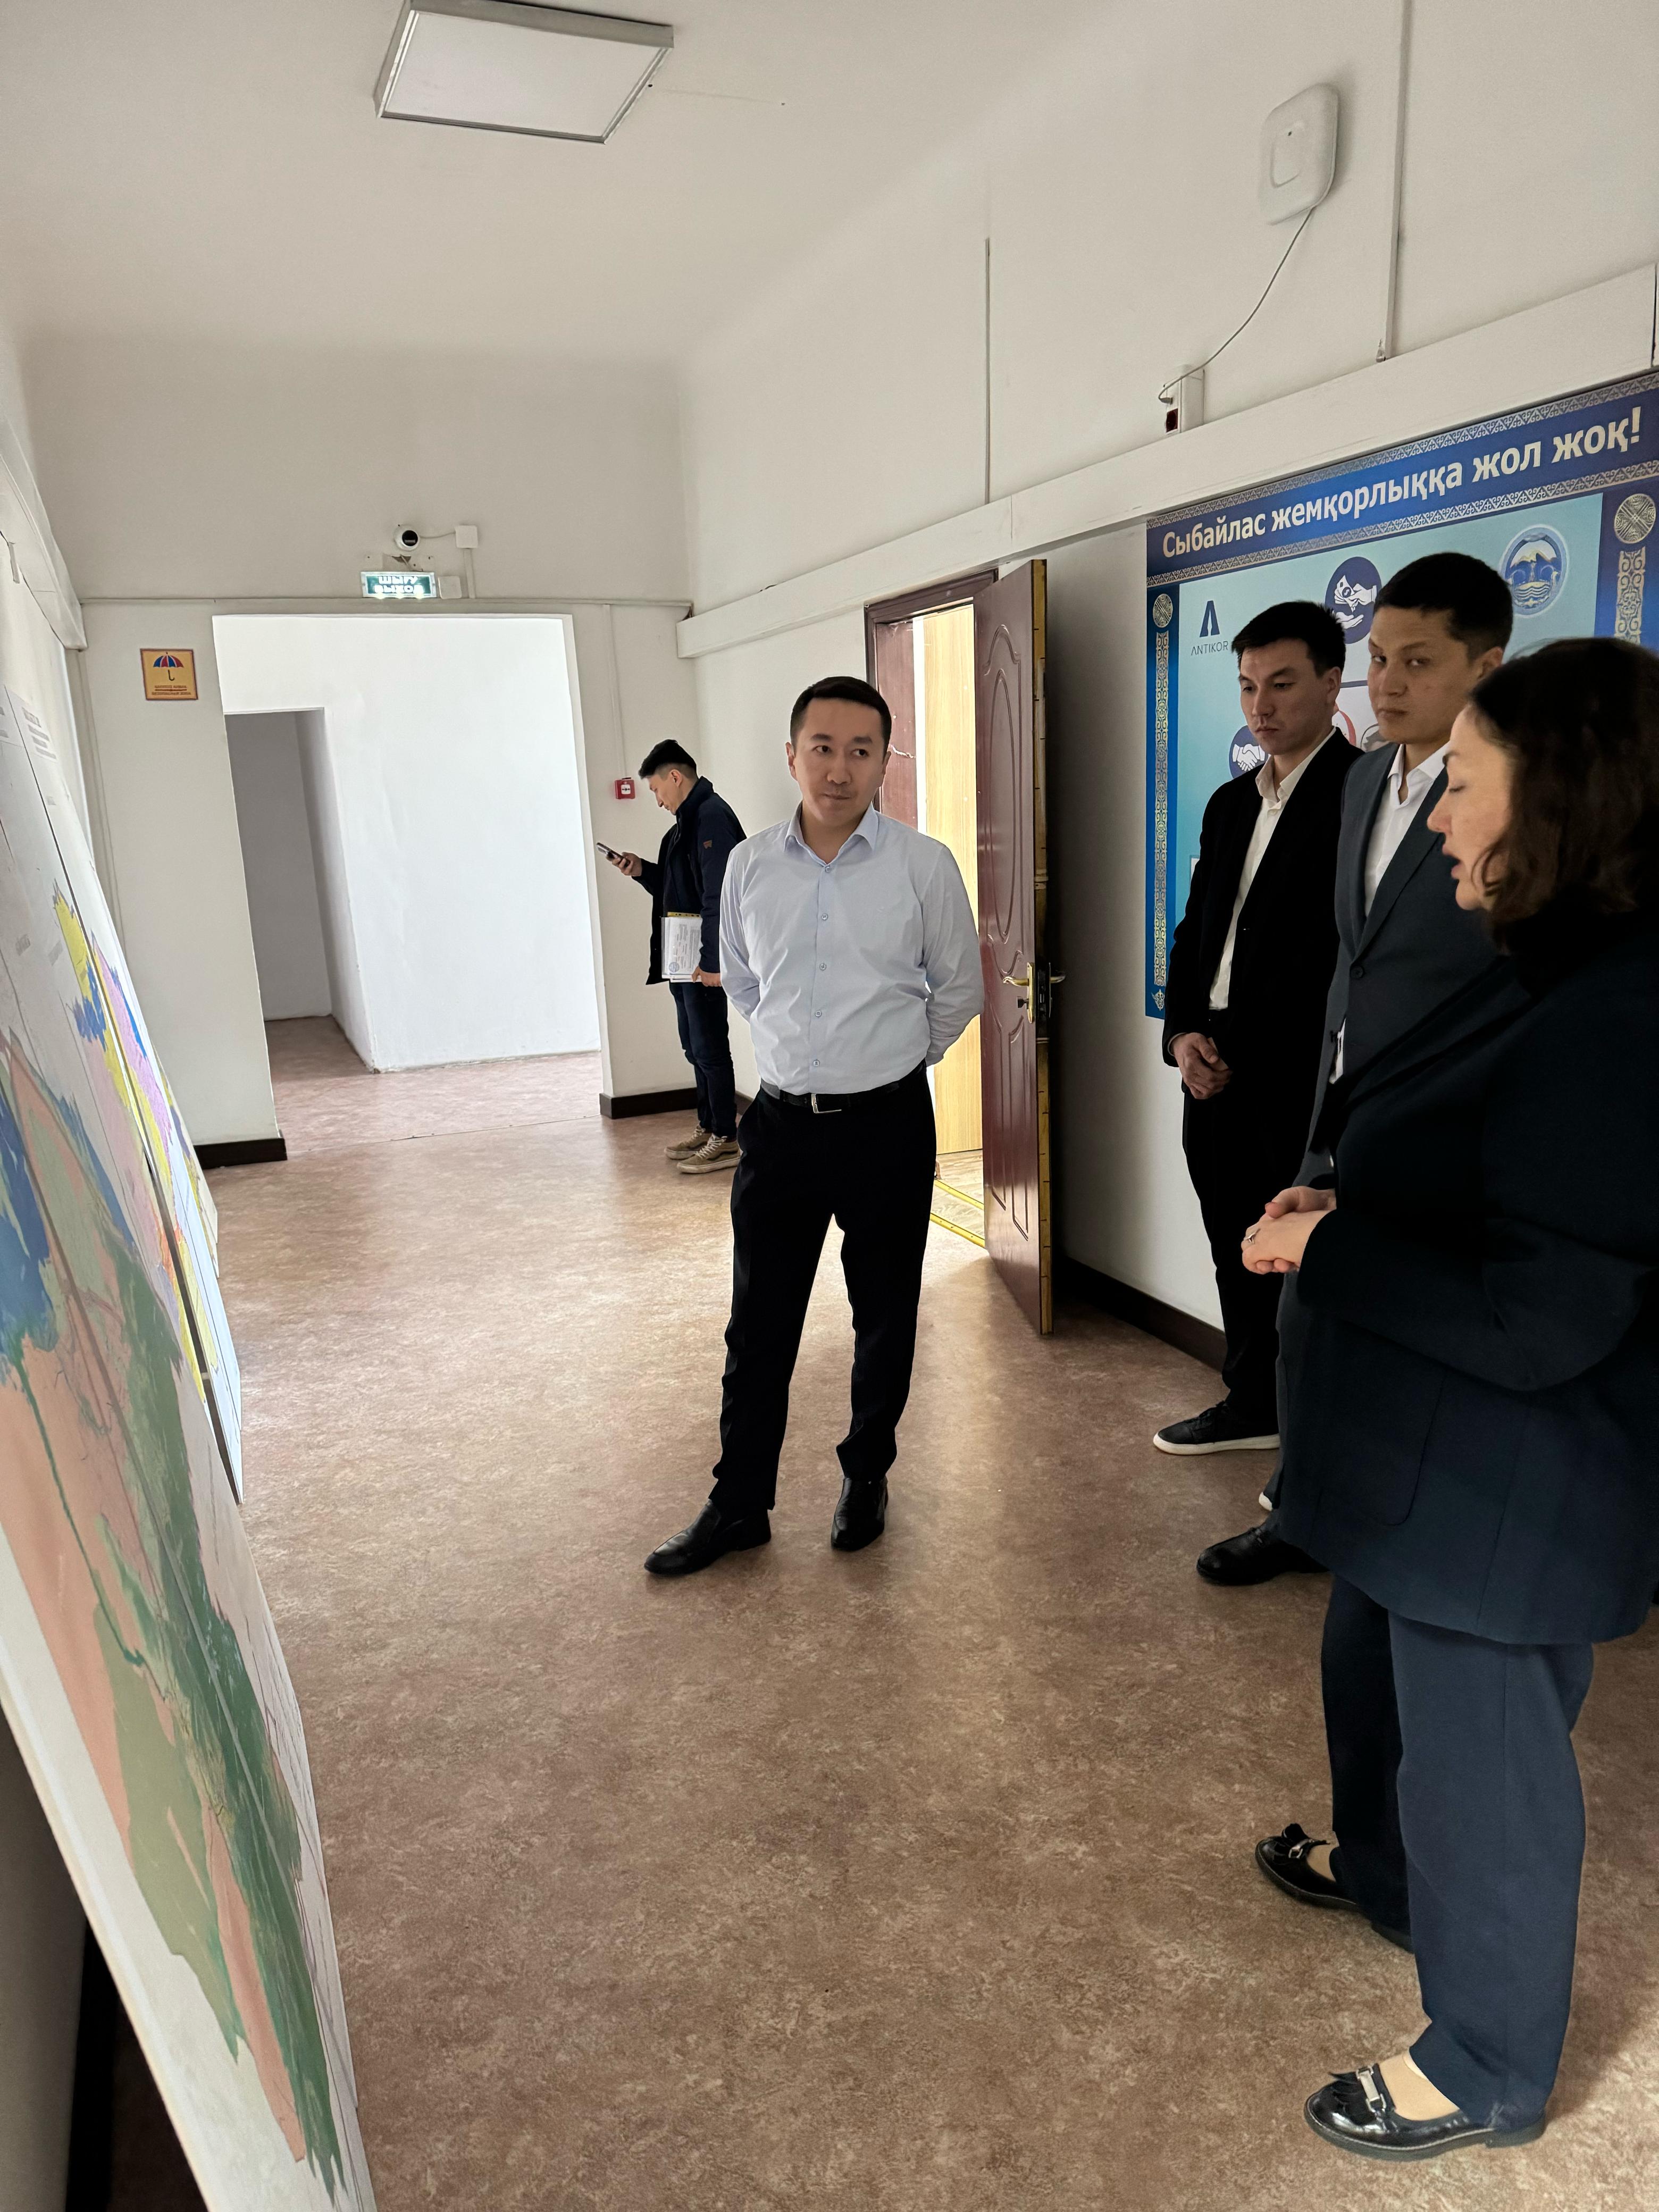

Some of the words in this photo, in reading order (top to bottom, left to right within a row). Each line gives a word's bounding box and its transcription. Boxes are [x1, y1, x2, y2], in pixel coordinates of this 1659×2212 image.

[1162, 515, 1266, 558] Сыбайлас
[1271, 462, 1463, 532] жемқорлыққа
[1472, 441, 1541, 483] жол
[1552, 406, 1641, 464] жоқ!
[1191, 641, 1228, 656] ANTIKOR
